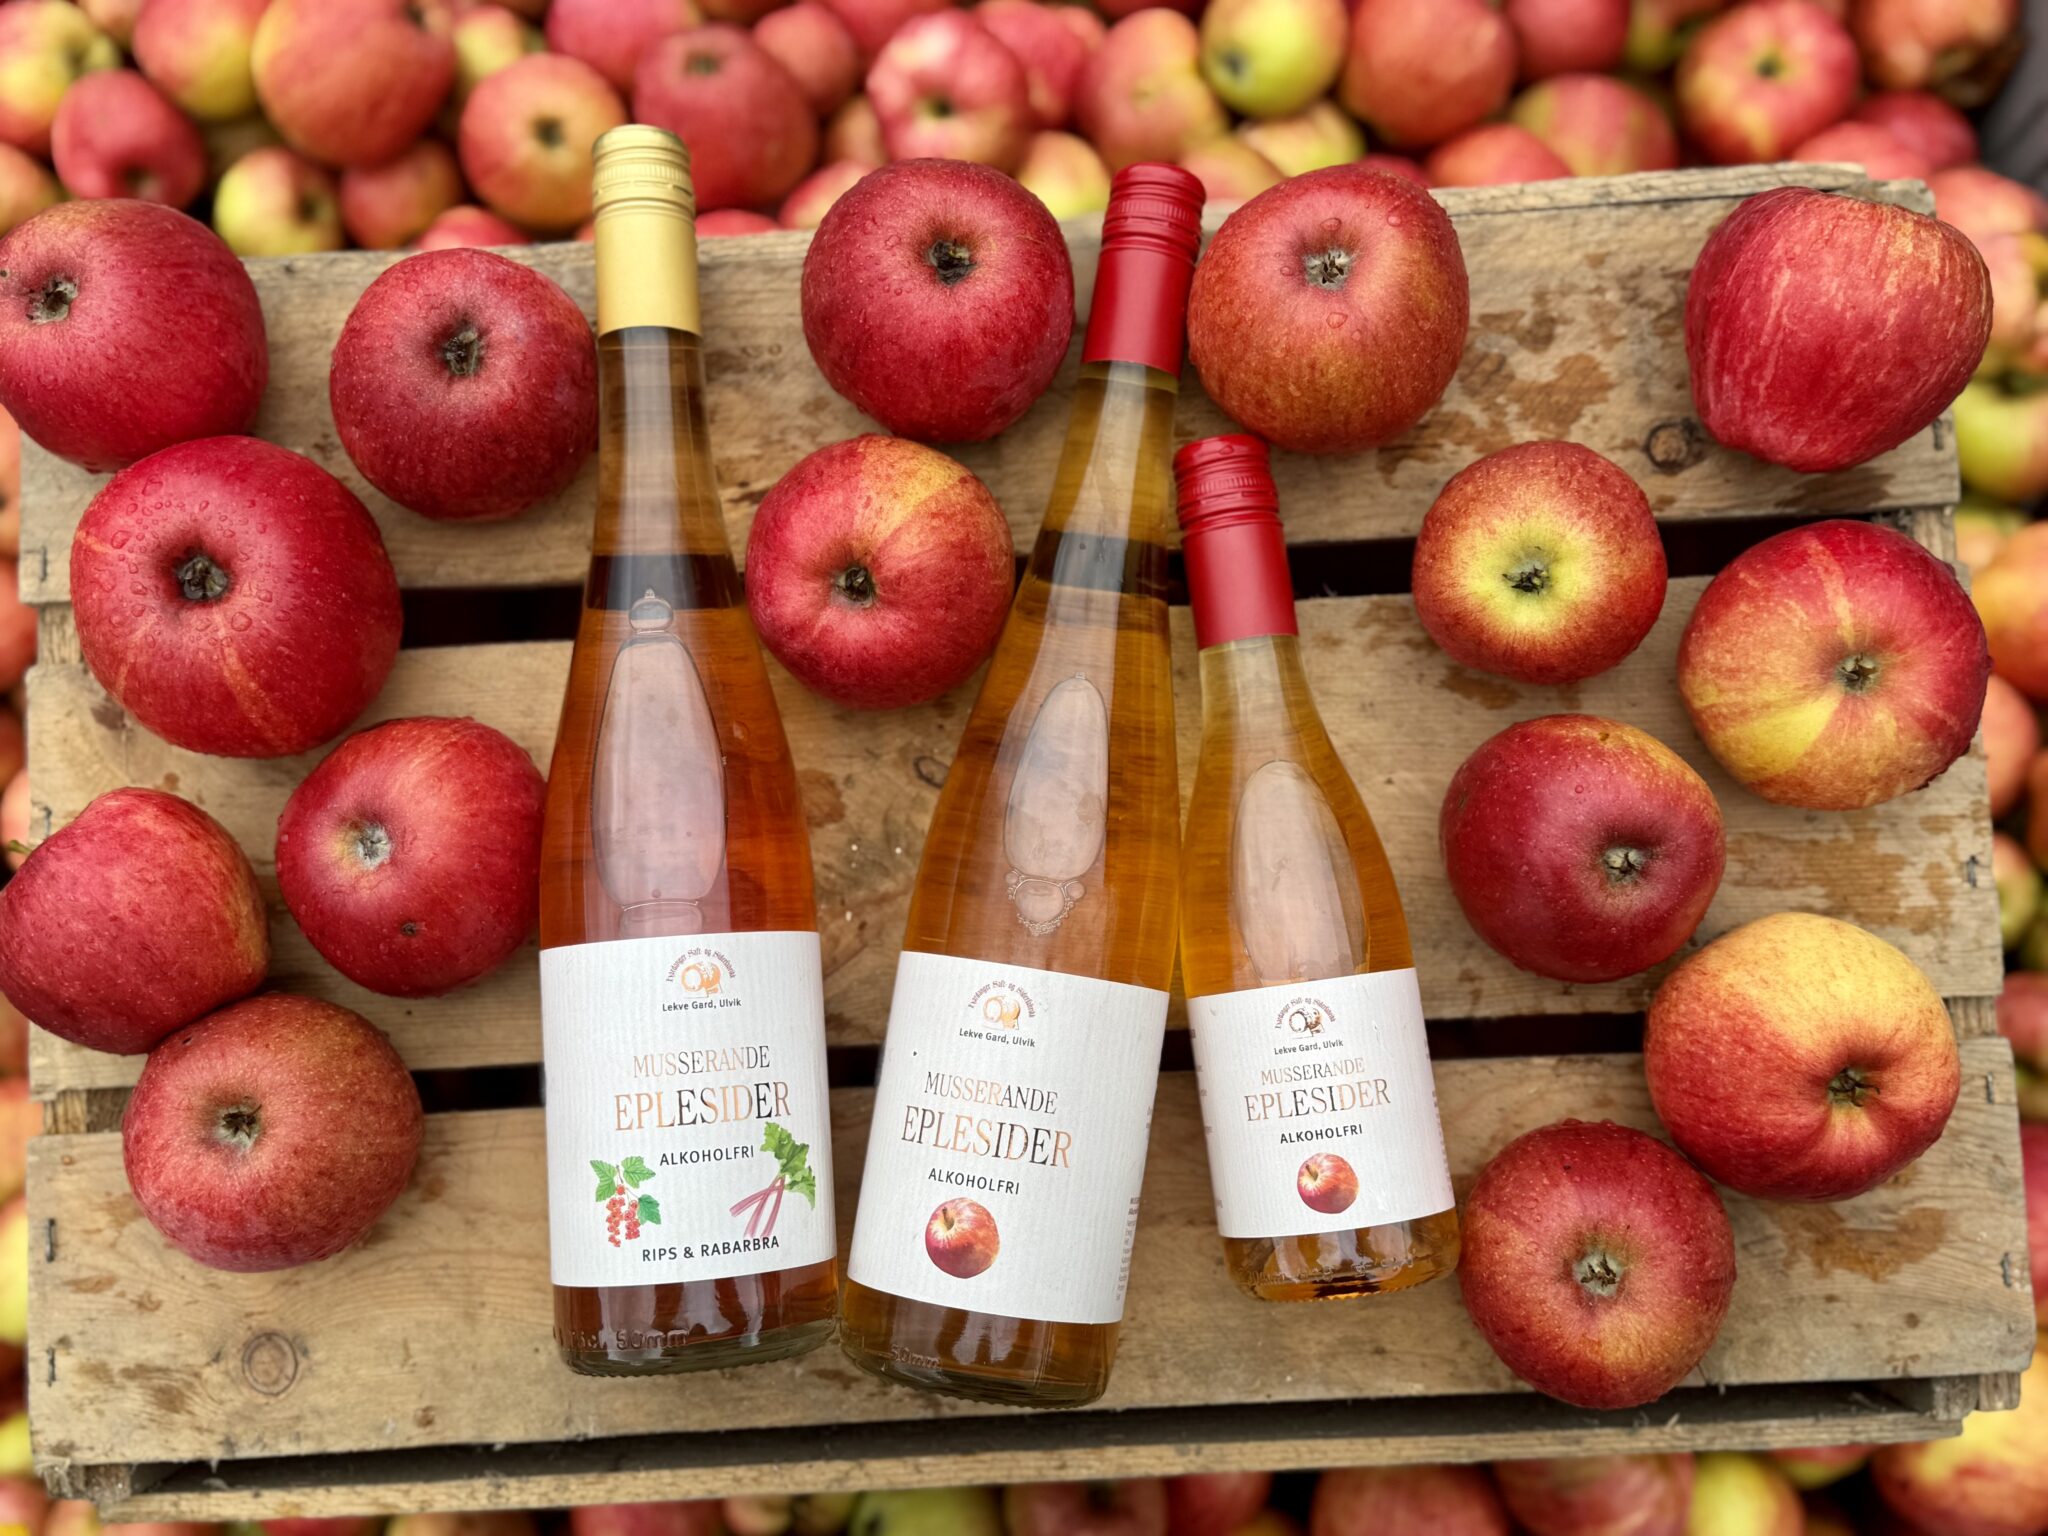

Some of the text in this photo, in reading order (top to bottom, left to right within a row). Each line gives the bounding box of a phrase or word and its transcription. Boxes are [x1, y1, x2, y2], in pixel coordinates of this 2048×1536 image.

[662, 998, 742, 1012] Lekve Gard, Ulvik
[959, 1028, 1036, 1048] Lekve Gard, Ulvik
[1274, 1039, 1344, 1055] Lekve Gard, Ulvik
[633, 1045, 771, 1079] MUSSERANDE
[1260, 1057, 1365, 1085] MUSSERANDE
[614, 1081, 791, 1131] EPLESIDER
[924, 1071, 1058, 1115] MUSSERANDE
[1243, 1078, 1391, 1122] EPLESIDER
[901, 1105, 1072, 1168] EPLESIDER
[1280, 1123, 1363, 1145] ALKOHOLFRI
[659, 1145, 754, 1166] ALKOHOLFRI
[928, 1167, 1020, 1195] ALKOHOLFRI
[642, 1235, 780, 1262] RIPS & RABARBRA
